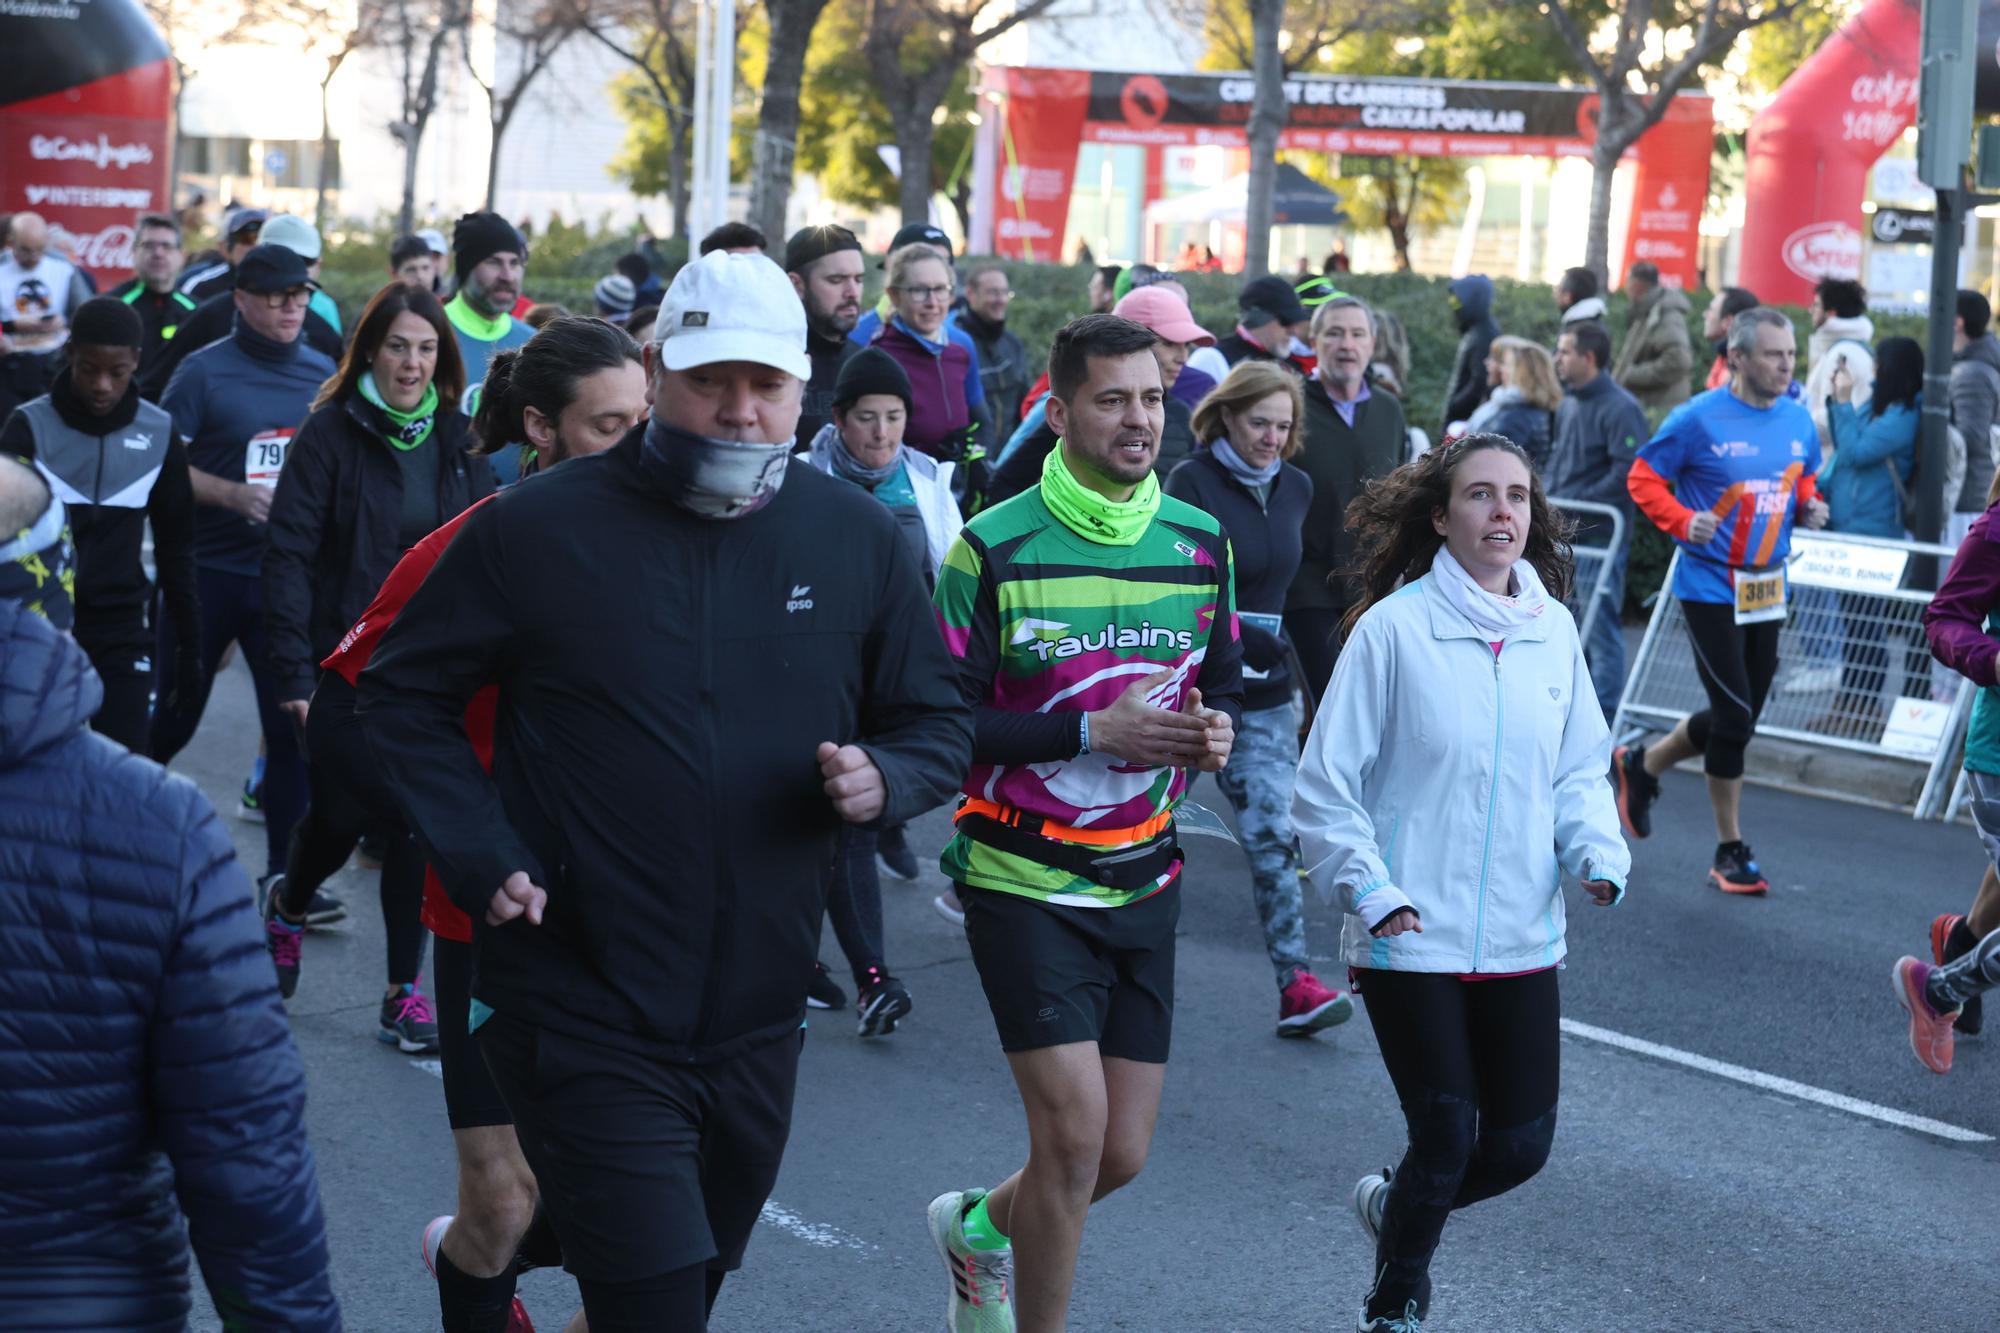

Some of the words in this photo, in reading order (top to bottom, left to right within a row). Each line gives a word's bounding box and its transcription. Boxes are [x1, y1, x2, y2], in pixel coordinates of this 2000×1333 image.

[1219, 80, 1303, 103] CIRIT
[1304, 82, 1334, 105] DE
[1335, 83, 1446, 108] CARRERES
[258, 443, 288, 466] 79
